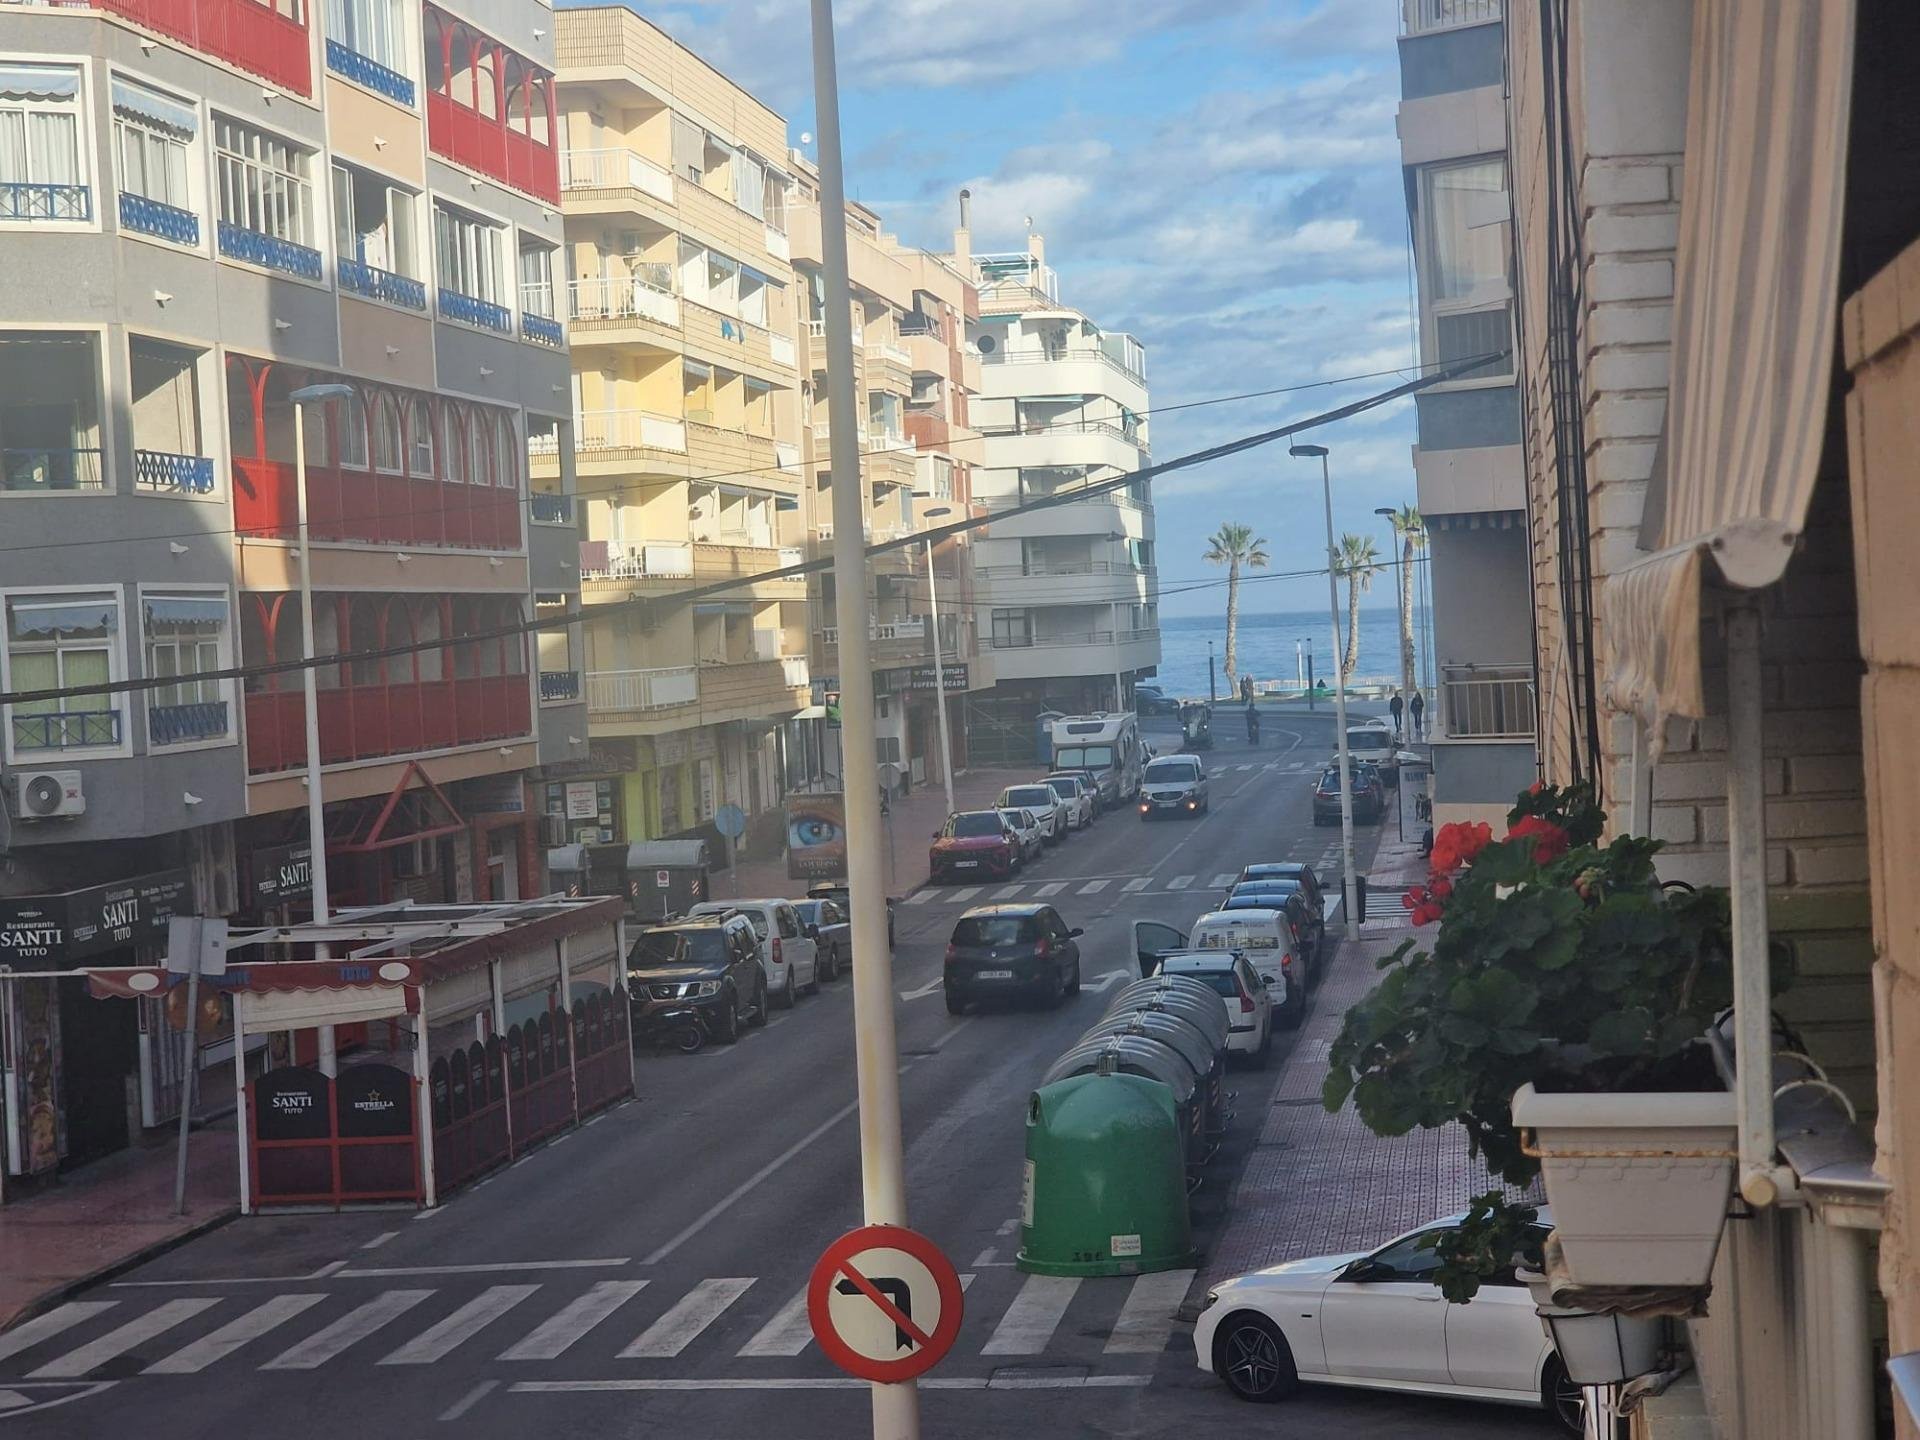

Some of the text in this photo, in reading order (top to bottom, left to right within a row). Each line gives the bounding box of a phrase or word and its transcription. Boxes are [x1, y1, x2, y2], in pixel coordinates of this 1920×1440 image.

[280, 862, 309, 888] SANTI
[102, 898, 139, 929] SANTI
[6, 921, 55, 929] Restaurante
[0, 929, 64, 947] SANTI
[113, 926, 132, 942] TUTO
[17, 947, 48, 957] TUTO
[272, 1096, 313, 1108] SANTI
[354, 1101, 395, 1109] ESTRELLA
